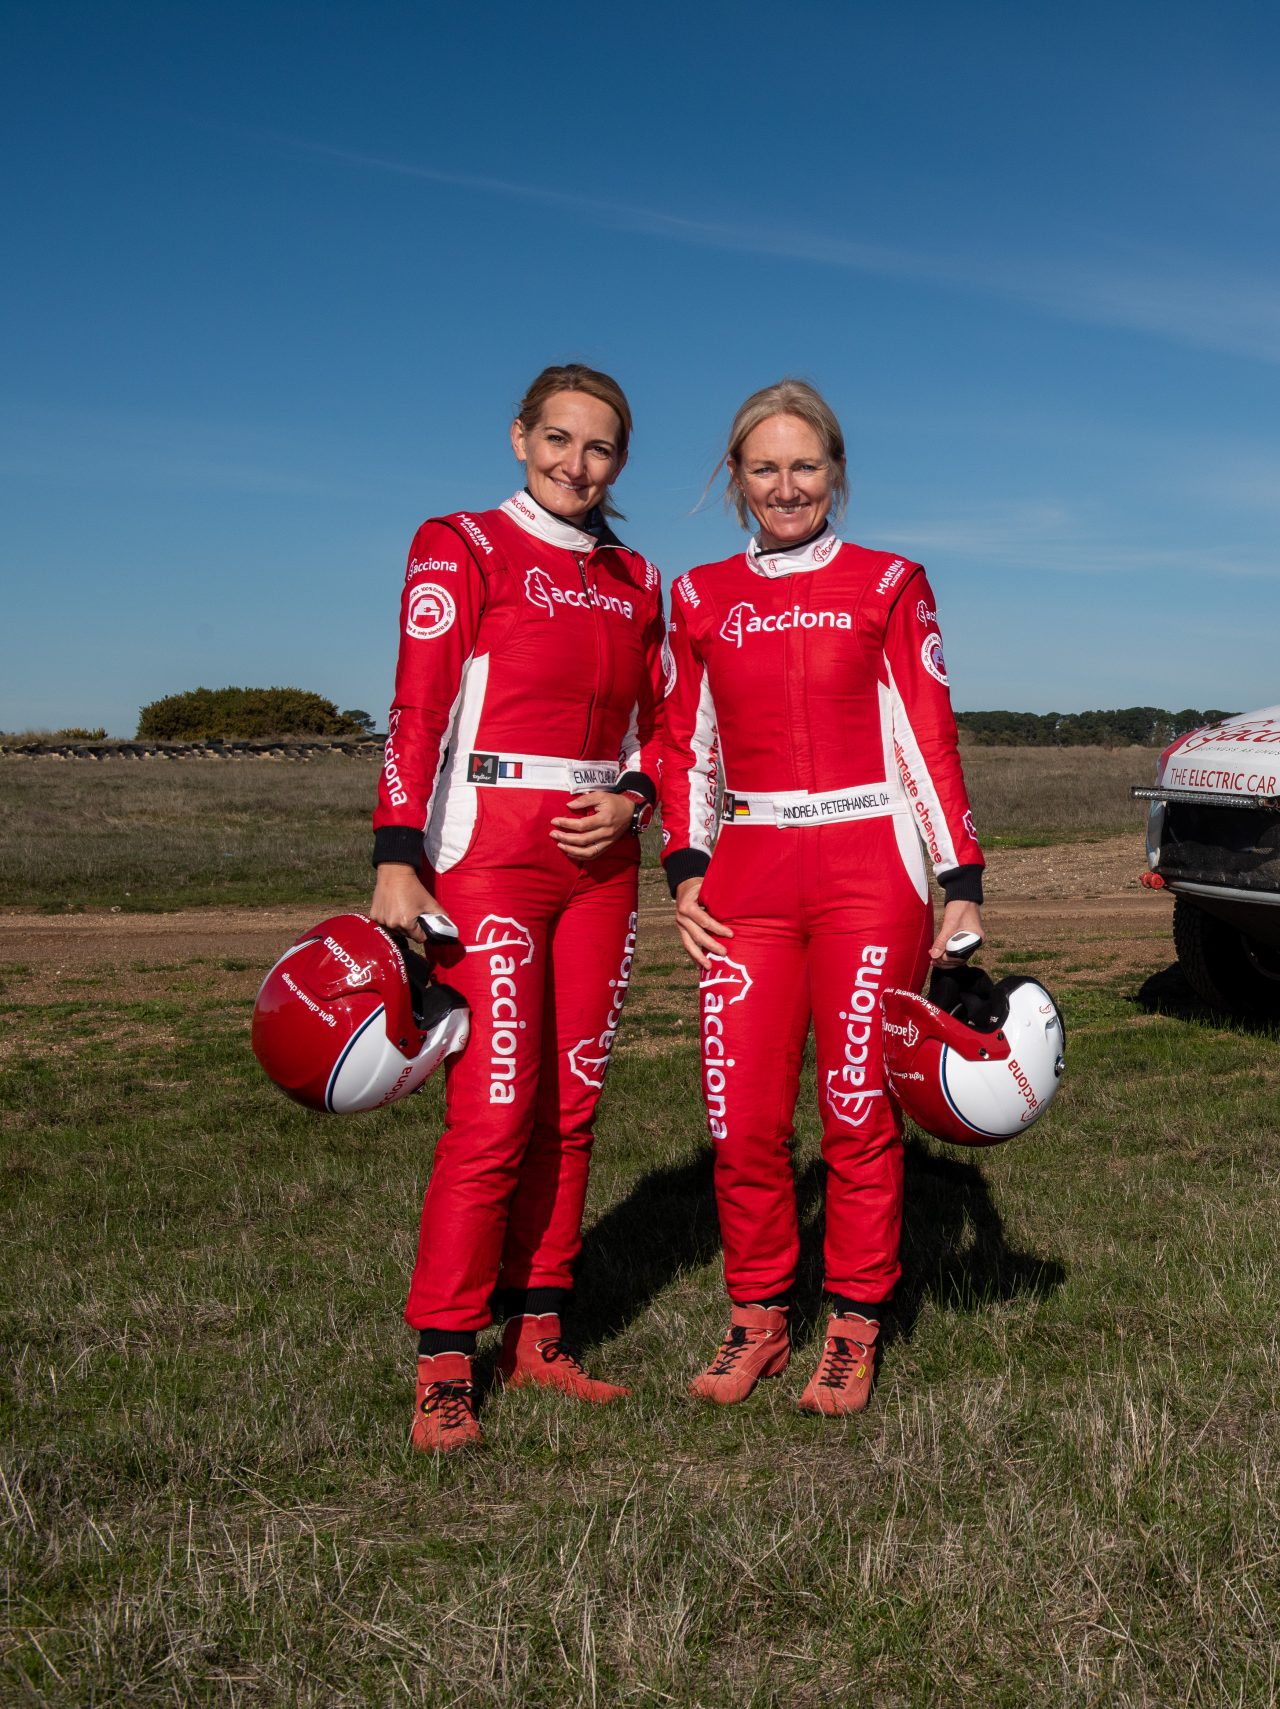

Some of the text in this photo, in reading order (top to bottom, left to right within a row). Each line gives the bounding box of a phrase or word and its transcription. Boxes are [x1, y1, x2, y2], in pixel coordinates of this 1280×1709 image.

[457, 514, 494, 555] MARINA
[413, 557, 458, 574] acciona
[875, 559, 905, 595] MARINA
[550, 584, 633, 620] acciona
[745, 605, 852, 632] acciona
[1170, 768, 1277, 795] THE ELECTRIC CAR
[783, 805, 819, 820] ANDREA
[820, 793, 880, 816] PETERHANSEL
[915, 801, 943, 864] change
[323, 936, 361, 974] acciona
[374, 926, 406, 966] EcoPowered
[598, 911, 639, 1048] acciona
[281, 972, 338, 1028] fight climate change
[839, 945, 888, 1087] acciona
[489, 955, 527, 1104] acciona
[704, 993, 735, 1140] acciona
[1008, 1058, 1037, 1109] acciona
